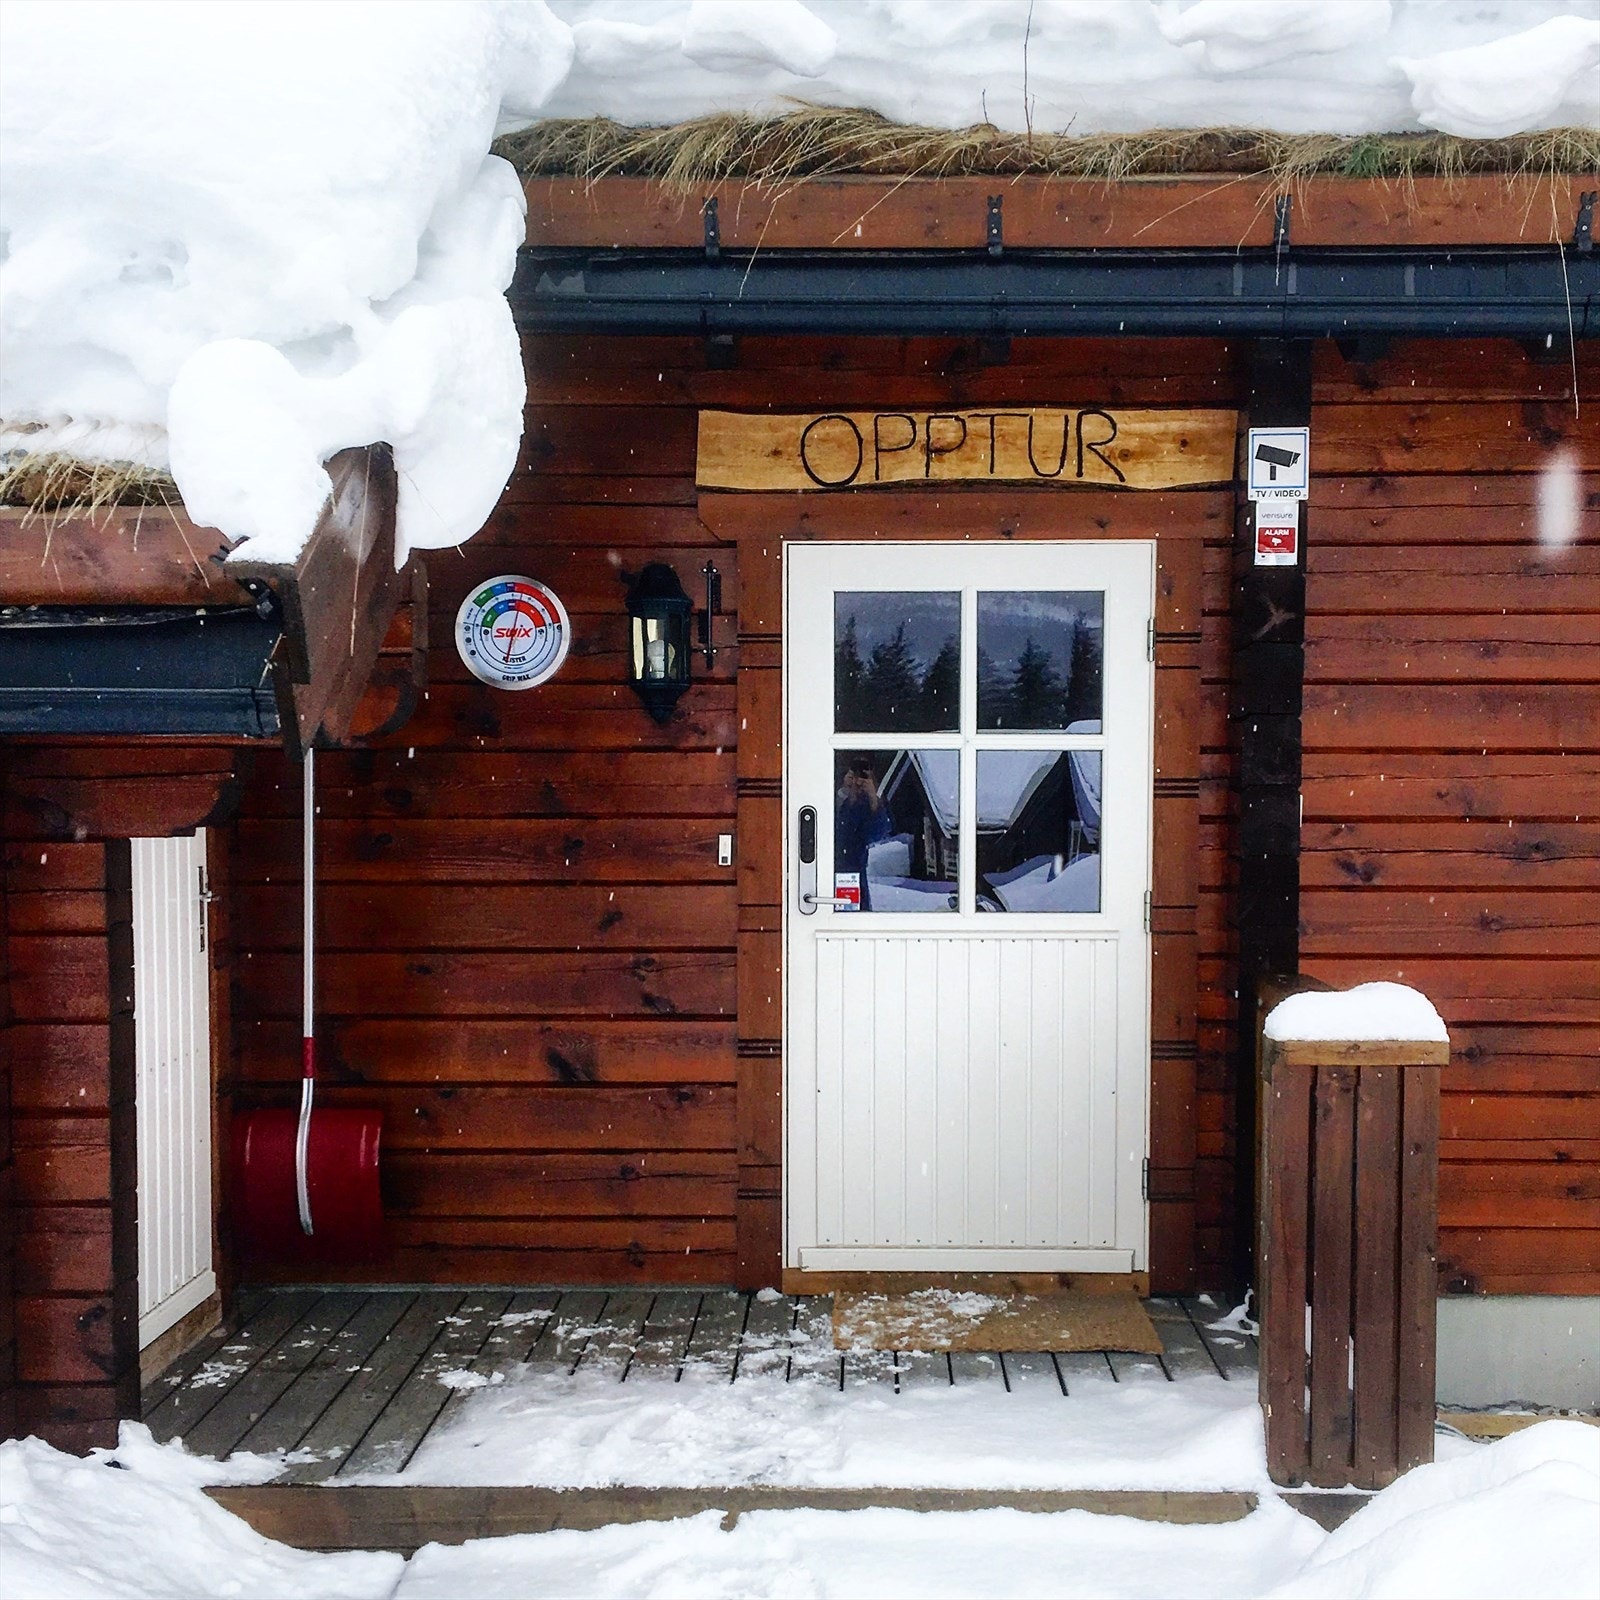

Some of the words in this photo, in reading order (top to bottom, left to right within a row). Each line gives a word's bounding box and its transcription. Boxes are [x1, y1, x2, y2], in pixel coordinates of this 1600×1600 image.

[800, 410, 1126, 488] OPPTUR
[1255, 490, 1267, 498] TV
[1274, 489, 1302, 498] VIDEO
[502, 655, 527, 664] KISTER
